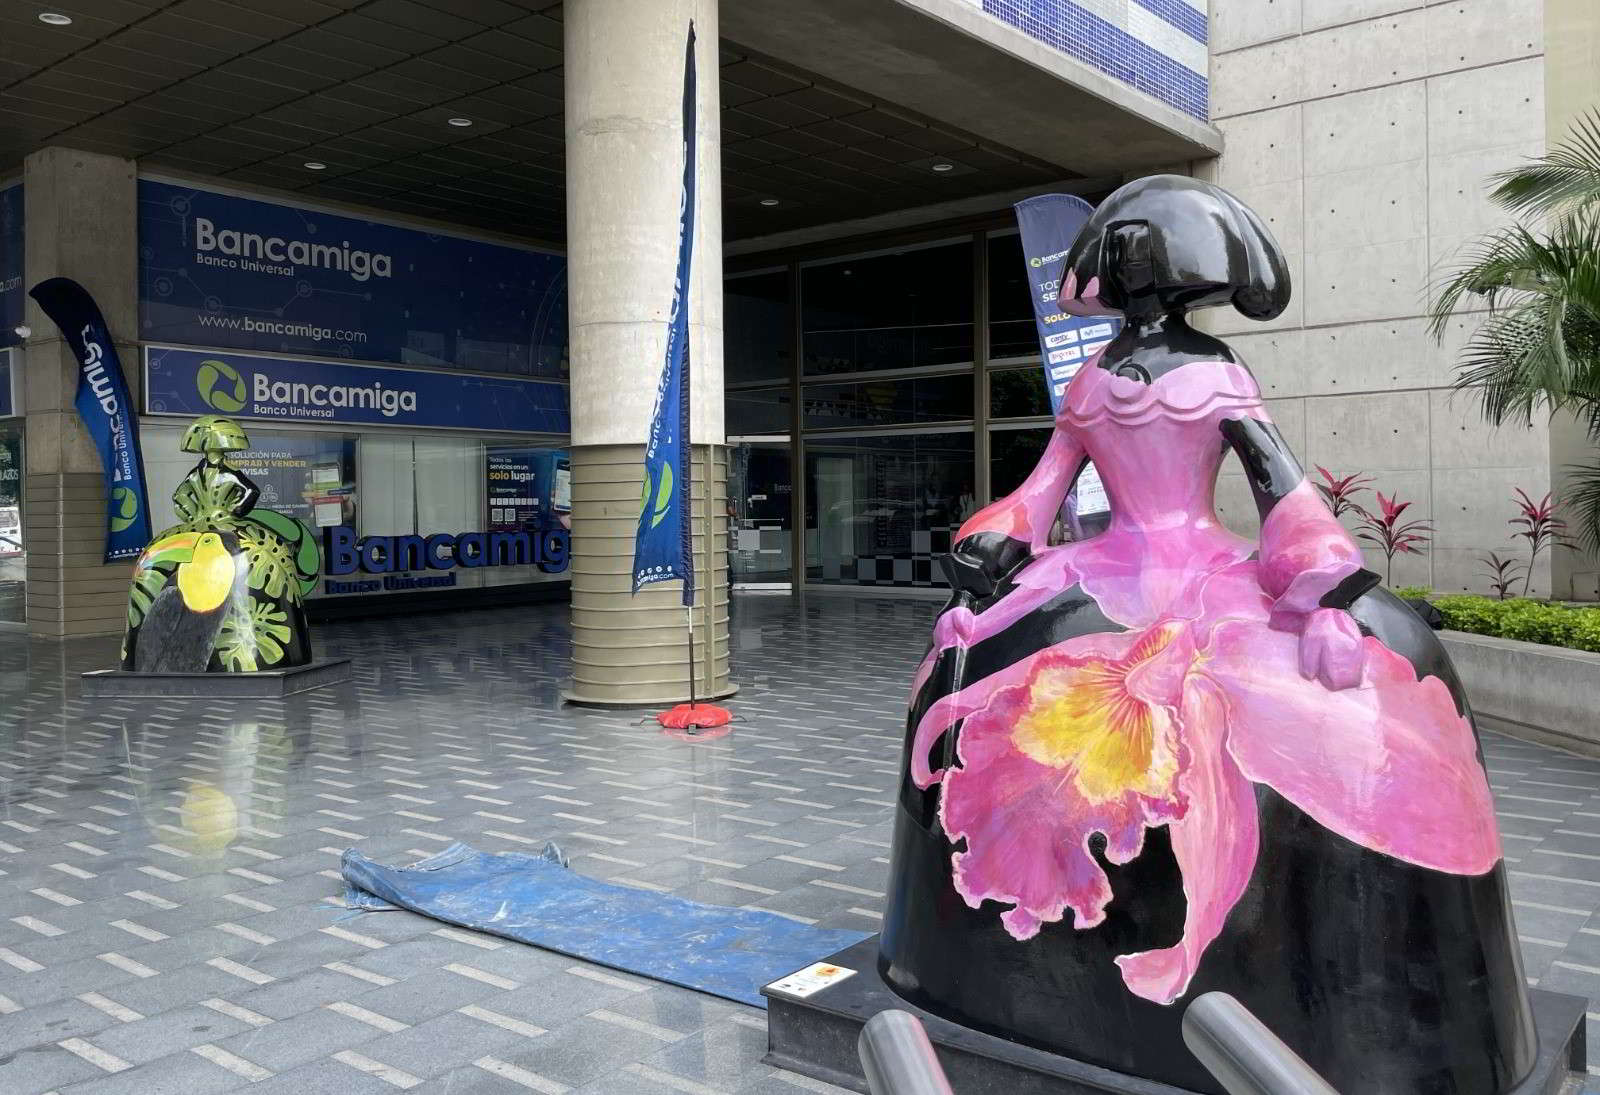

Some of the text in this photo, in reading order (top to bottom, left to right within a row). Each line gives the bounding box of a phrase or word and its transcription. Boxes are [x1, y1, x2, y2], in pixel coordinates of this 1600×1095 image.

[196, 217, 392, 281] Bancamiga
[196, 253, 295, 276] Banco Universal
[1042, 291, 1058, 303] SE
[198, 315, 367, 343] www.bancamiga.com
[254, 373, 417, 417] Bancamiga
[254, 404, 335, 418] Banco Universal
[121, 450, 132, 481] Banco
[229, 459, 264, 468] MPRAR
[271, 460, 306, 468] VENDER
[230, 450, 270, 459] SOLUCIÓN
[240, 467, 269, 476] IVISAS
[489, 470, 535, 482] solo lugar
[323, 526, 571, 574] Bancamig
[325, 572, 456, 594] Banco Universal
